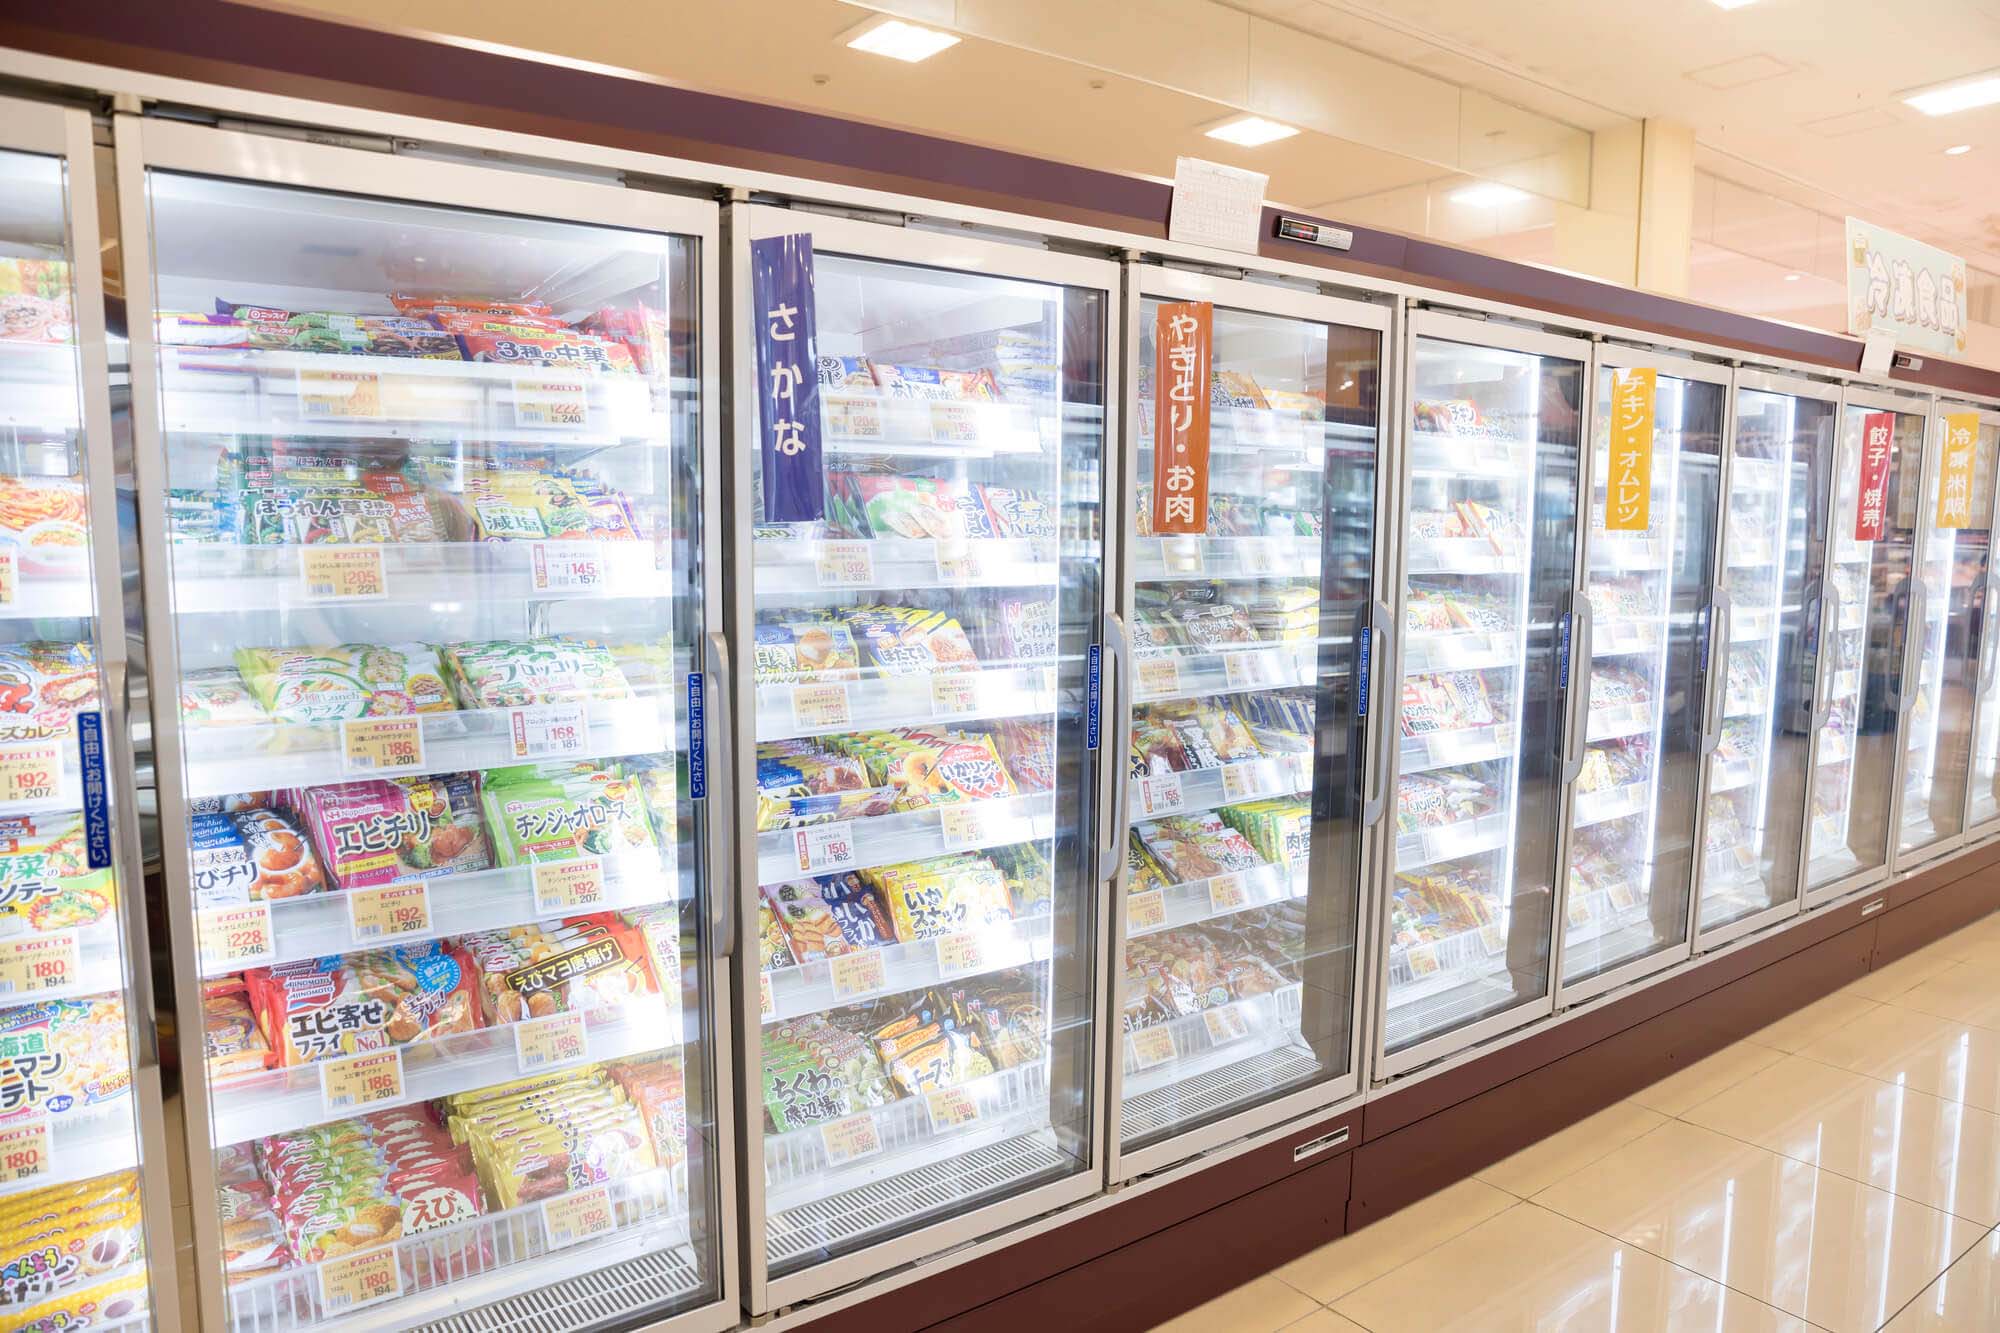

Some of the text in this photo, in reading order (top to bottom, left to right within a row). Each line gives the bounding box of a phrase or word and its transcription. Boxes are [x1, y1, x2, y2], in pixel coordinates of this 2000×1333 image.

[496, 341, 609, 362] 3種の中華
[768, 302, 807, 456] さかな
[562, 415, 581, 424] 240
[1165, 313, 1198, 523] やきとり・お肉
[1617, 375, 1645, 523] チキン・オムレツ
[1862, 427, 1888, 527] 餃子・焼売
[256, 500, 361, 516] ほうれん草
[572, 563, 595, 574] 145
[349, 570, 377, 584] 205
[579, 575, 596, 584] 157
[358, 585, 377, 594] 221
[551, 726, 574, 740] 168
[387, 741, 413, 755] 186
[396, 755, 415, 765] 201
[16, 772, 48, 788] 192
[24, 787, 50, 799] 207
[516, 801, 631, 838] チンジャオロース
[335, 811, 430, 856] エビチリ
[828, 842, 847, 854] 150
[833, 854, 849, 862] 162
[574, 881, 595, 895] 192
[579, 895, 597, 904] 207
[394, 907, 420, 922] 192
[402, 920, 422, 931] 207
[231, 930, 263, 947] 228
[240, 944, 264, 956] 246
[34, 960, 65, 977] 180
[515, 943, 613, 993] えびマヨ唐揚げ
[44, 976, 66, 989] 194
[291, 1002, 383, 1038] エビ寄せ
[295, 1033, 340, 1057] フライ
[557, 1035, 578, 1049] 186
[564, 1048, 580, 1058] 201
[368, 1075, 393, 1090] 186
[772, 1069, 844, 1105] ちくわの
[376, 1088, 395, 1099] 201
[5, 1150, 37, 1170] 180
[16, 1165, 39, 1179] 194
[412, 1190, 457, 1228] えび
[590, 1222, 607, 1232] 207
[366, 1270, 390, 1289] 180
[374, 1286, 391, 1297] 194
